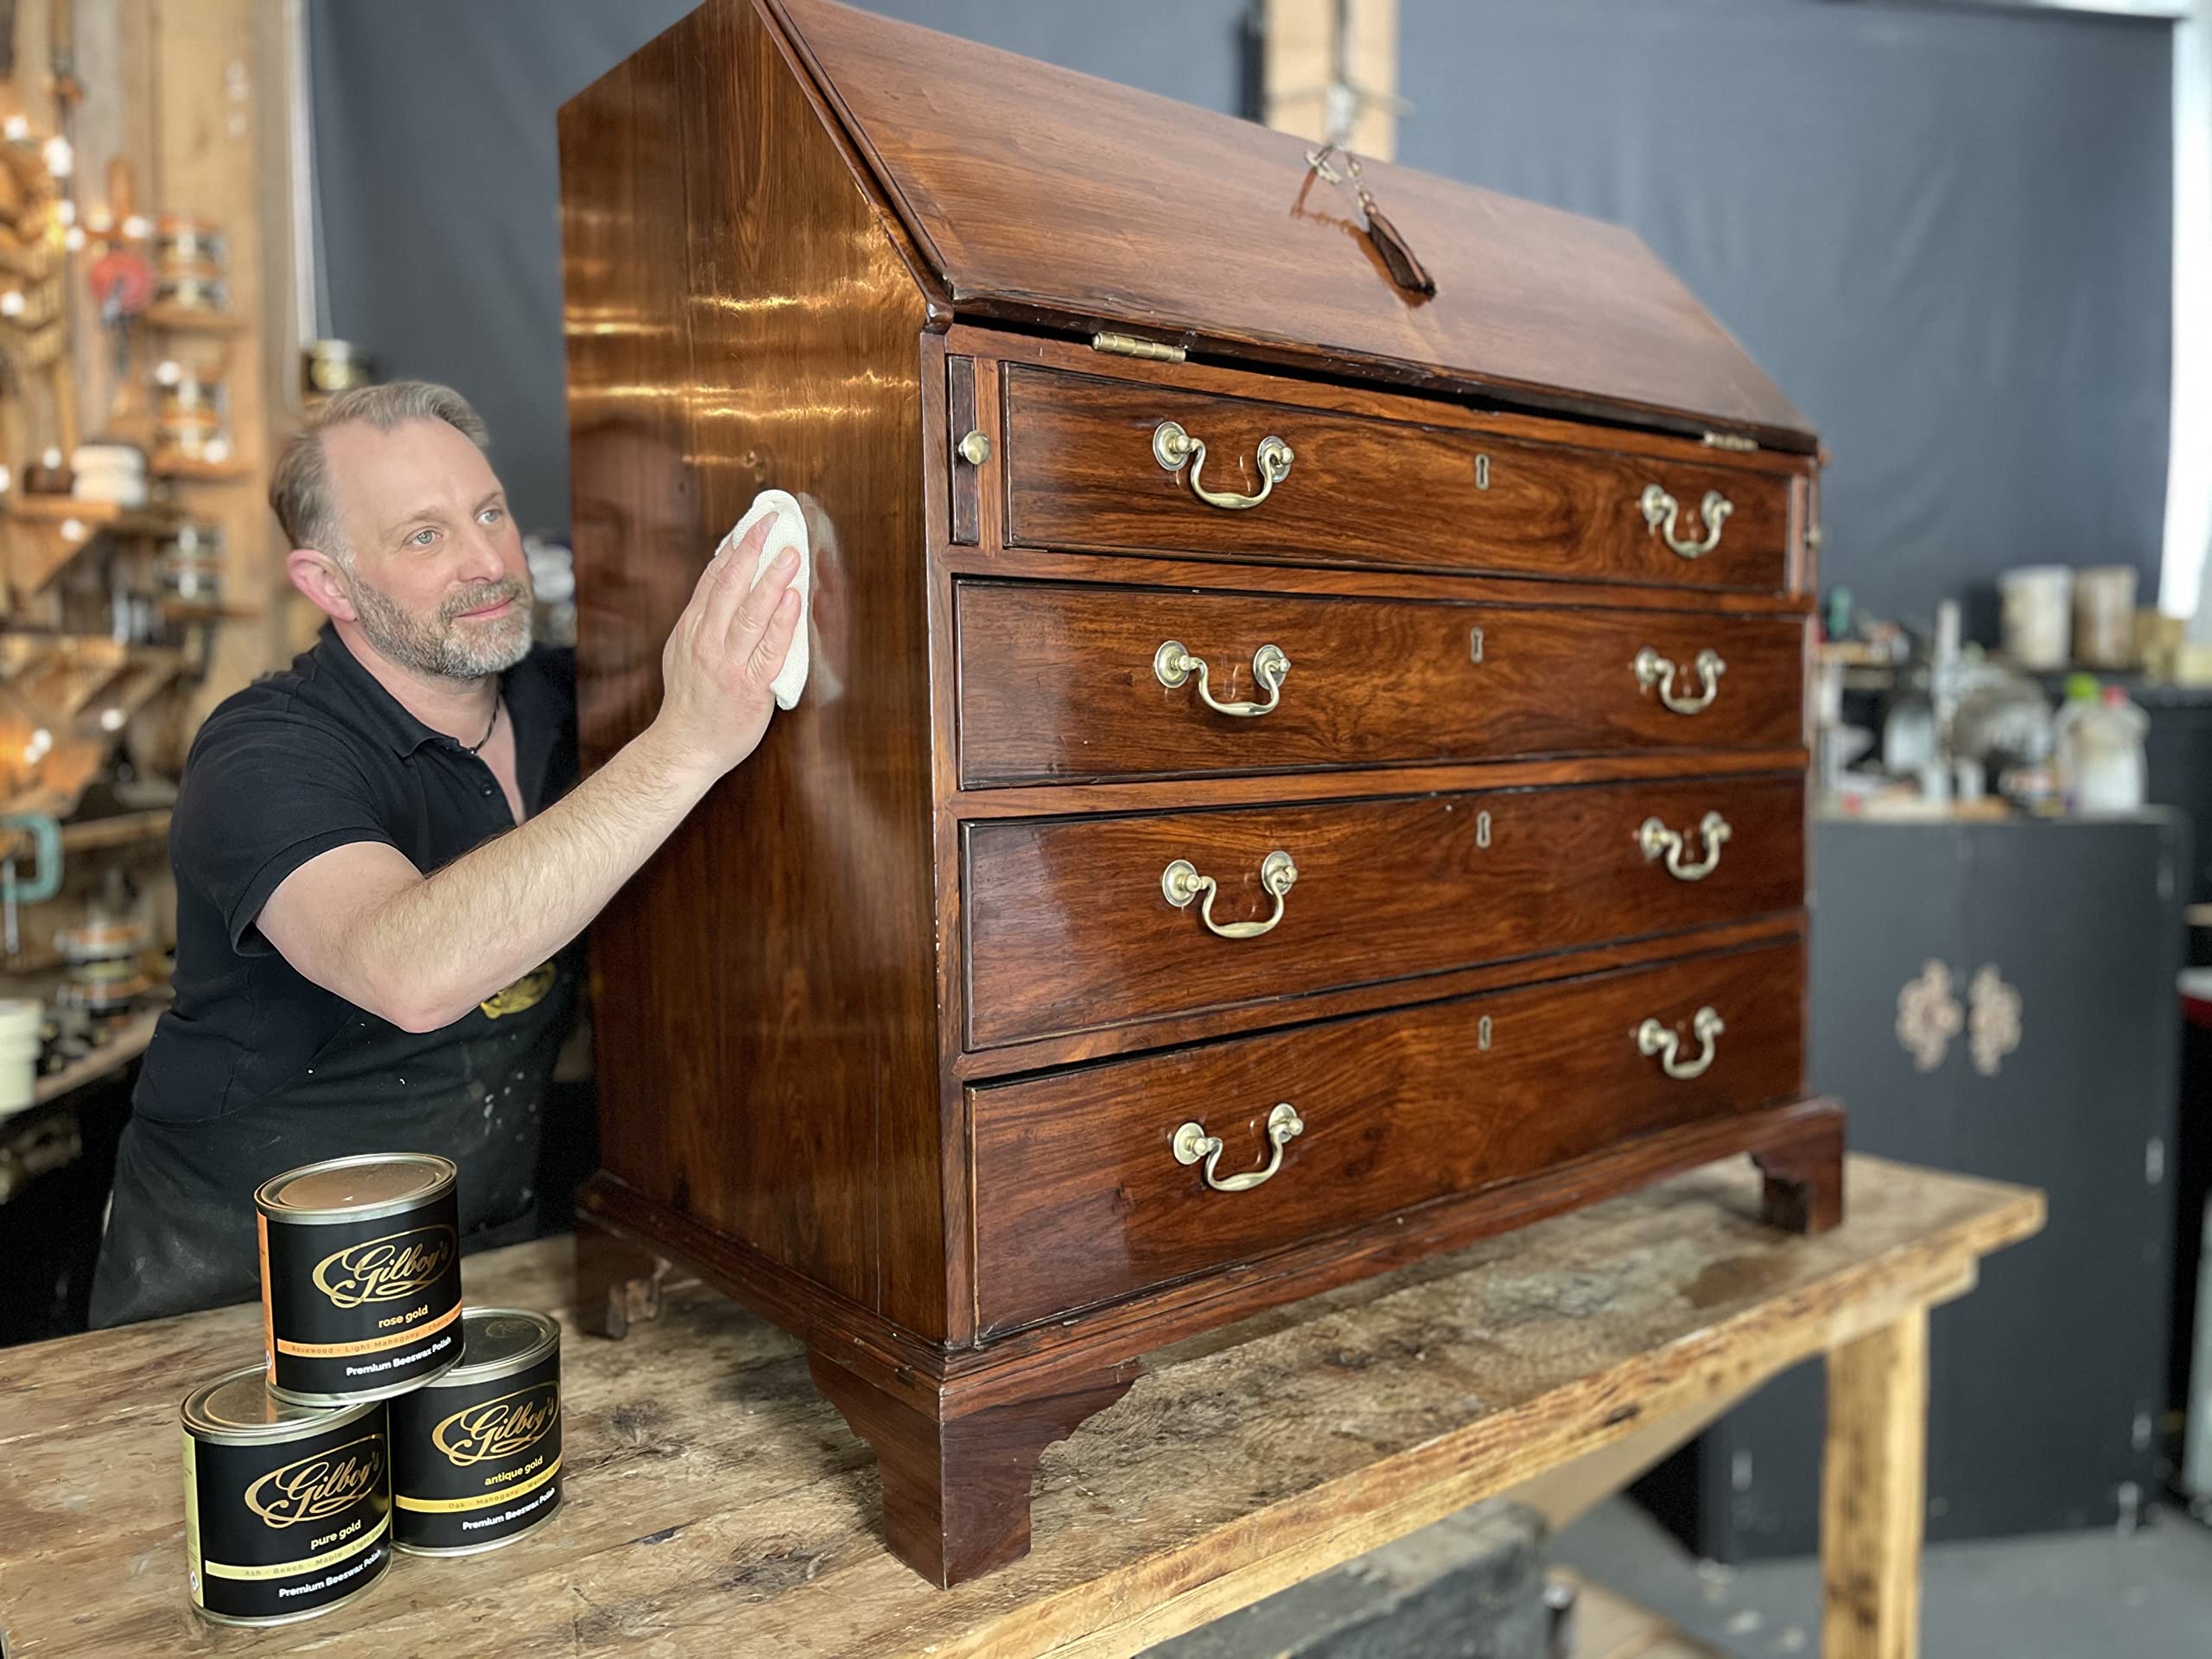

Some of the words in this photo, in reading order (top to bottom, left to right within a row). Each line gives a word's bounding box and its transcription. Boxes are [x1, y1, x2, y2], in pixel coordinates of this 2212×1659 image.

[330, 1240, 449, 1308] Gilboy's
[378, 1316, 404, 1328] rose
[404, 1304, 429, 1324] gold
[291, 1345, 334, 1354] Rosewood
[346, 1344, 371, 1353] Light
[374, 1332, 420, 1348] Mahogany
[346, 1362, 391, 1376] Premium
[393, 1349, 432, 1367] Beeswax
[432, 1337, 452, 1354] Polish
[449, 1397, 554, 1466] Gilboy's
[485, 1468, 524, 1486] antique
[524, 1455, 543, 1474] gold
[263, 1452, 380, 1529] Gilboy's
[462, 1516, 505, 1530] Premium
[505, 1502, 539, 1521] Beeswax
[539, 1487, 556, 1504] Polish
[476, 1490, 519, 1505] Mahogany
[310, 1533, 338, 1550] pure
[339, 1519, 362, 1539] gold
[278, 1581, 325, 1598] Premium
[326, 1564, 364, 1587] Beeswax
[363, 1549, 382, 1569] Polish
